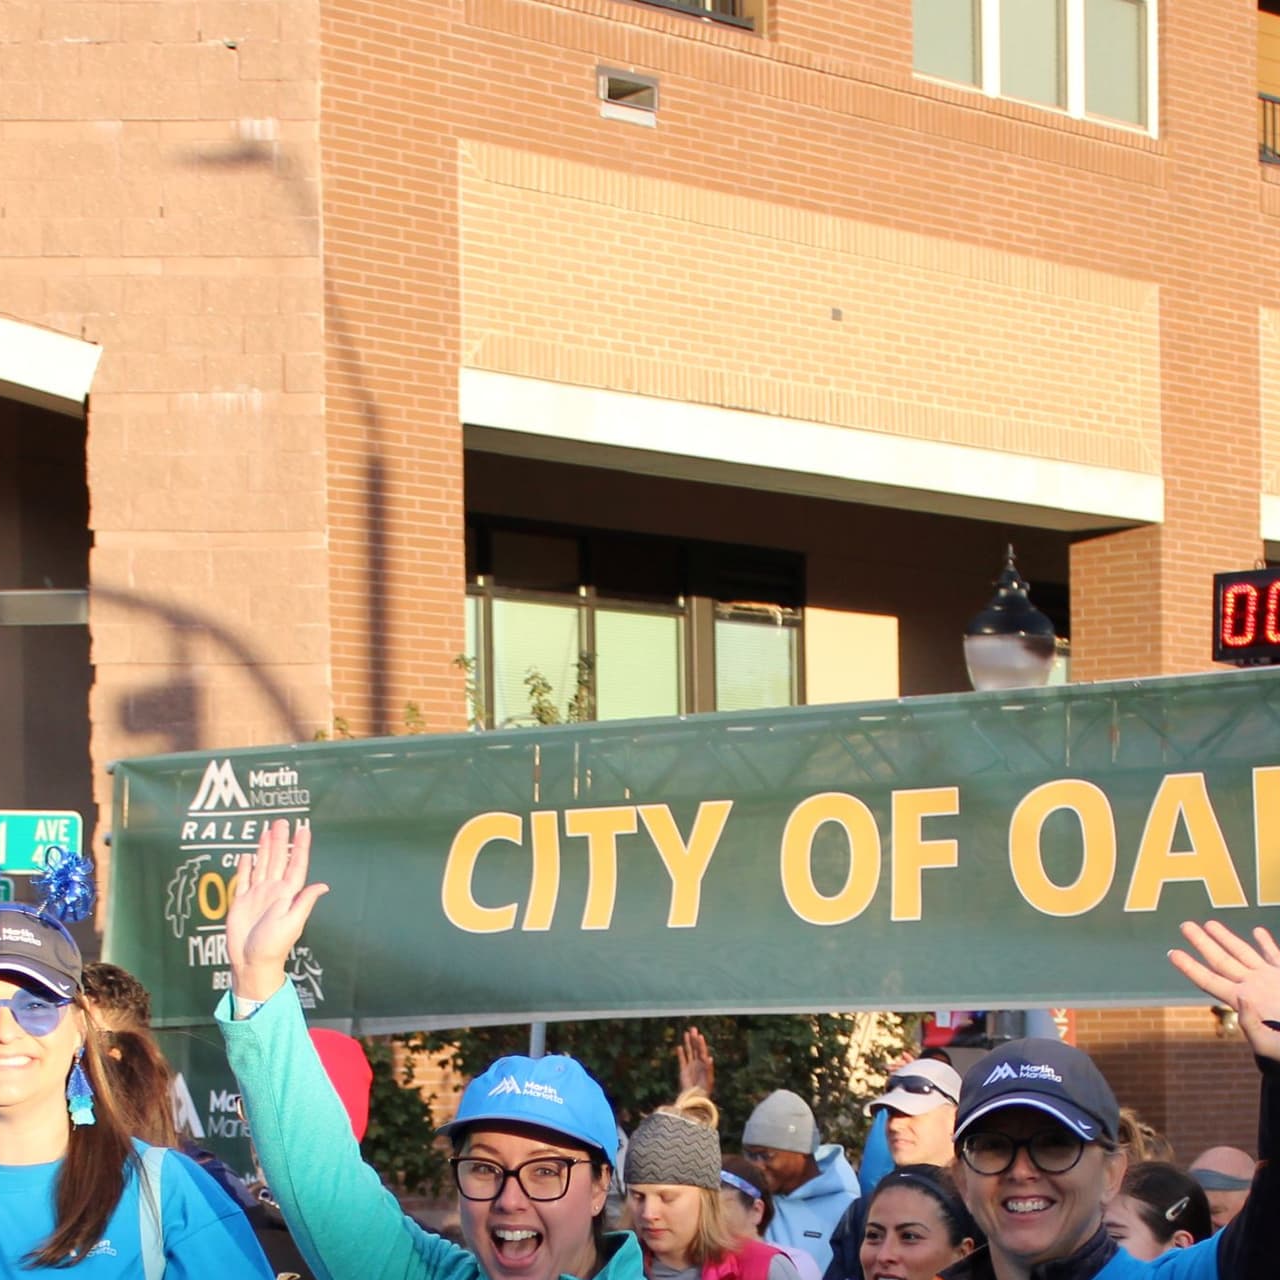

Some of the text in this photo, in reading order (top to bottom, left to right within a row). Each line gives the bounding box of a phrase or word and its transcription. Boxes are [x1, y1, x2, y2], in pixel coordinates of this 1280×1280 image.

[249, 765, 298, 788] Martin
[250, 787, 310, 807] Marietta
[34, 819, 70, 841] AVE
[439, 798, 735, 935] CITY
[779, 786, 960, 928] OF
